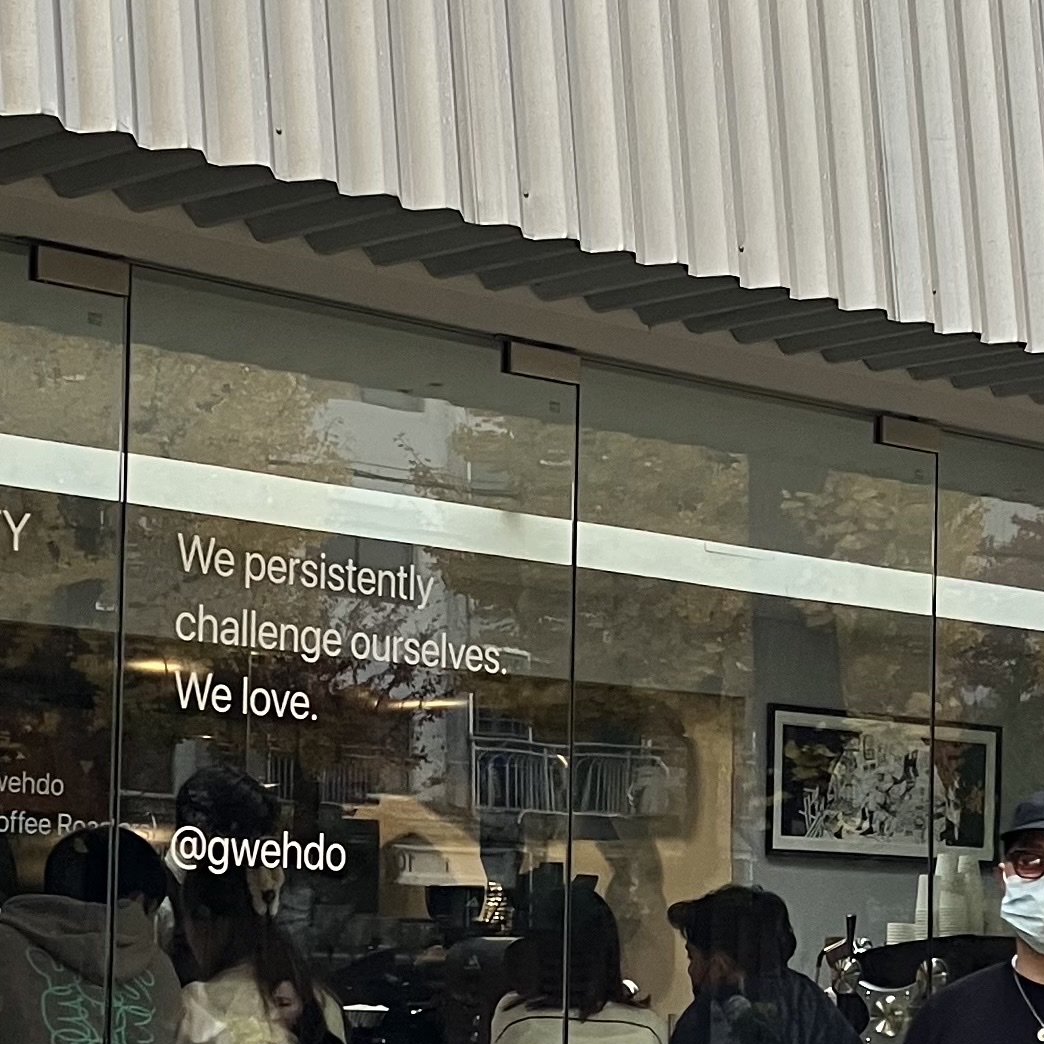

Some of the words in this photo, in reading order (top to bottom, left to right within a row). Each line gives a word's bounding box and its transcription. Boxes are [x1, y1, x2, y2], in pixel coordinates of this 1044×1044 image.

[0, 509, 31, 551] Y
[177, 532, 235, 578] We
[245, 552, 435, 610] persistently
[175, 604, 342, 664] challenge
[351, 632, 508, 675] ourselves.
[175, 670, 232, 713] We
[242, 676, 319, 721] love.
[170, 825, 347, 875] @gwehdo
